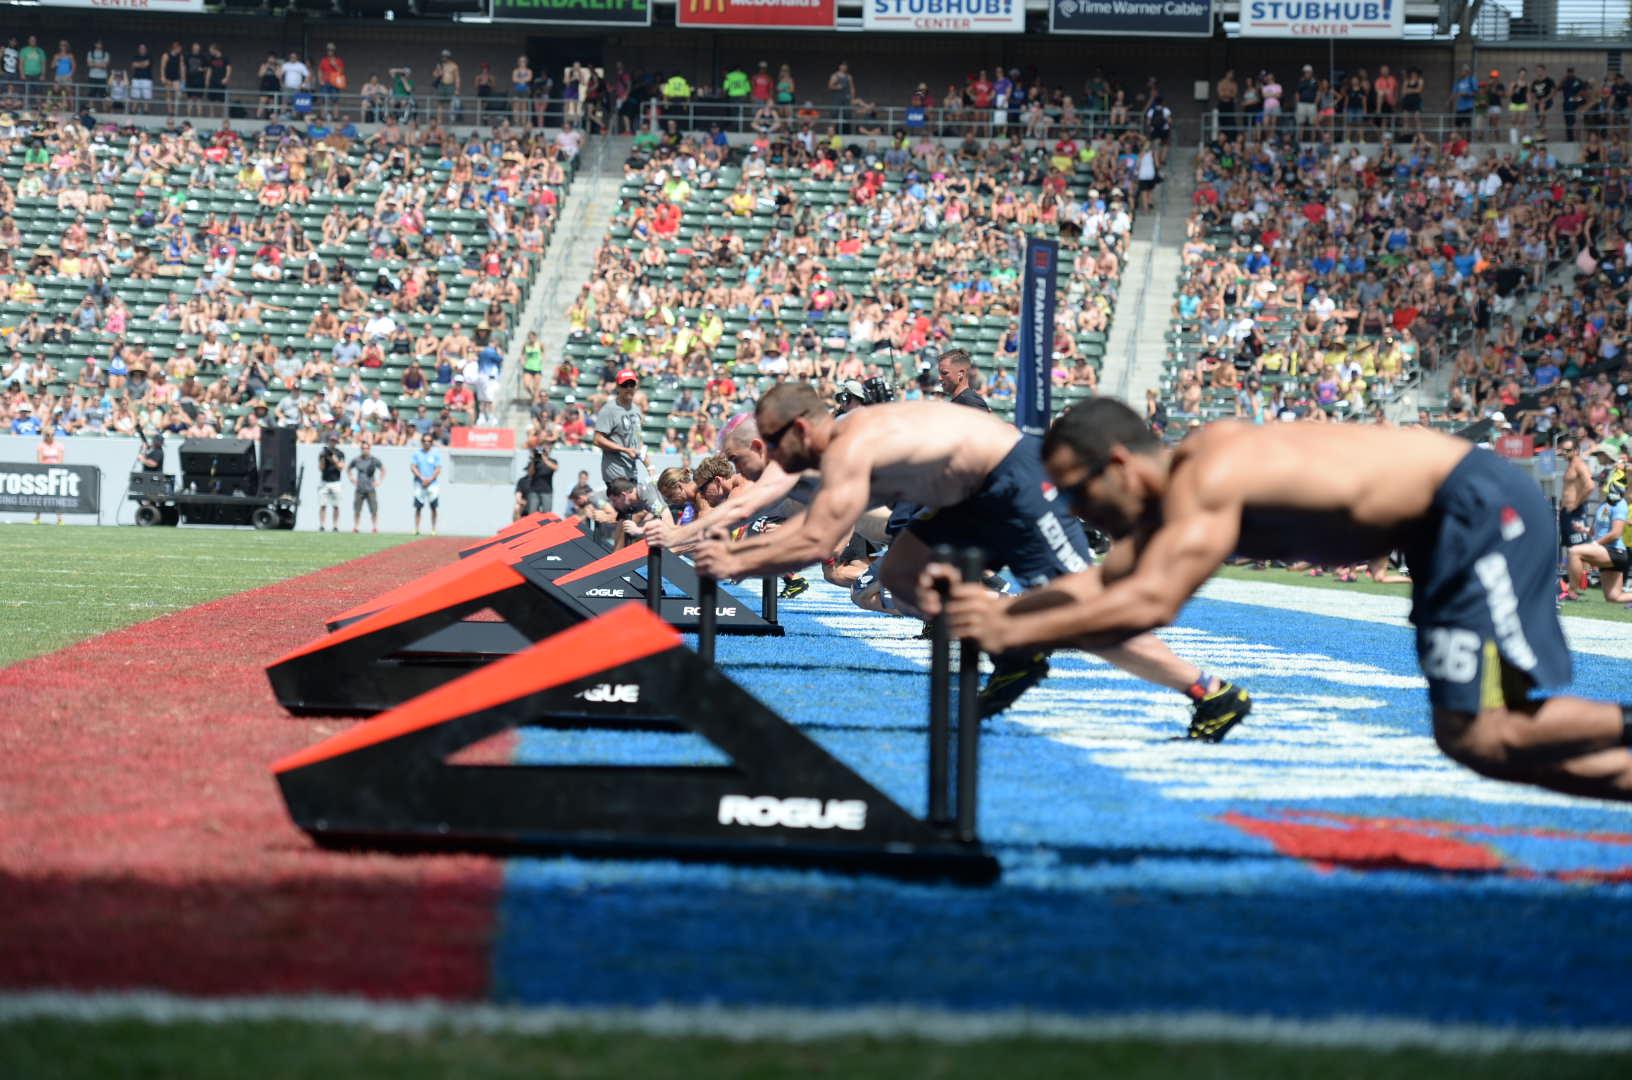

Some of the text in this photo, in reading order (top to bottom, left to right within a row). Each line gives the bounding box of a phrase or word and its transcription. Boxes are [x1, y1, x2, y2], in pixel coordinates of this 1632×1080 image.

[875, 0, 1012, 14] STUBHUB!
[1078, 1, 1112, 14] Time
[1113, 2, 1163, 15] Warner
[1251, 0, 1392, 20] STUBHUB!
[914, 18, 971, 29] CENTER
[1291, 23, 1349, 34] CENTER
[683, 606, 736, 617] ROUE
[574, 683, 640, 703] GUE
[718, 794, 868, 831] ROGUE
